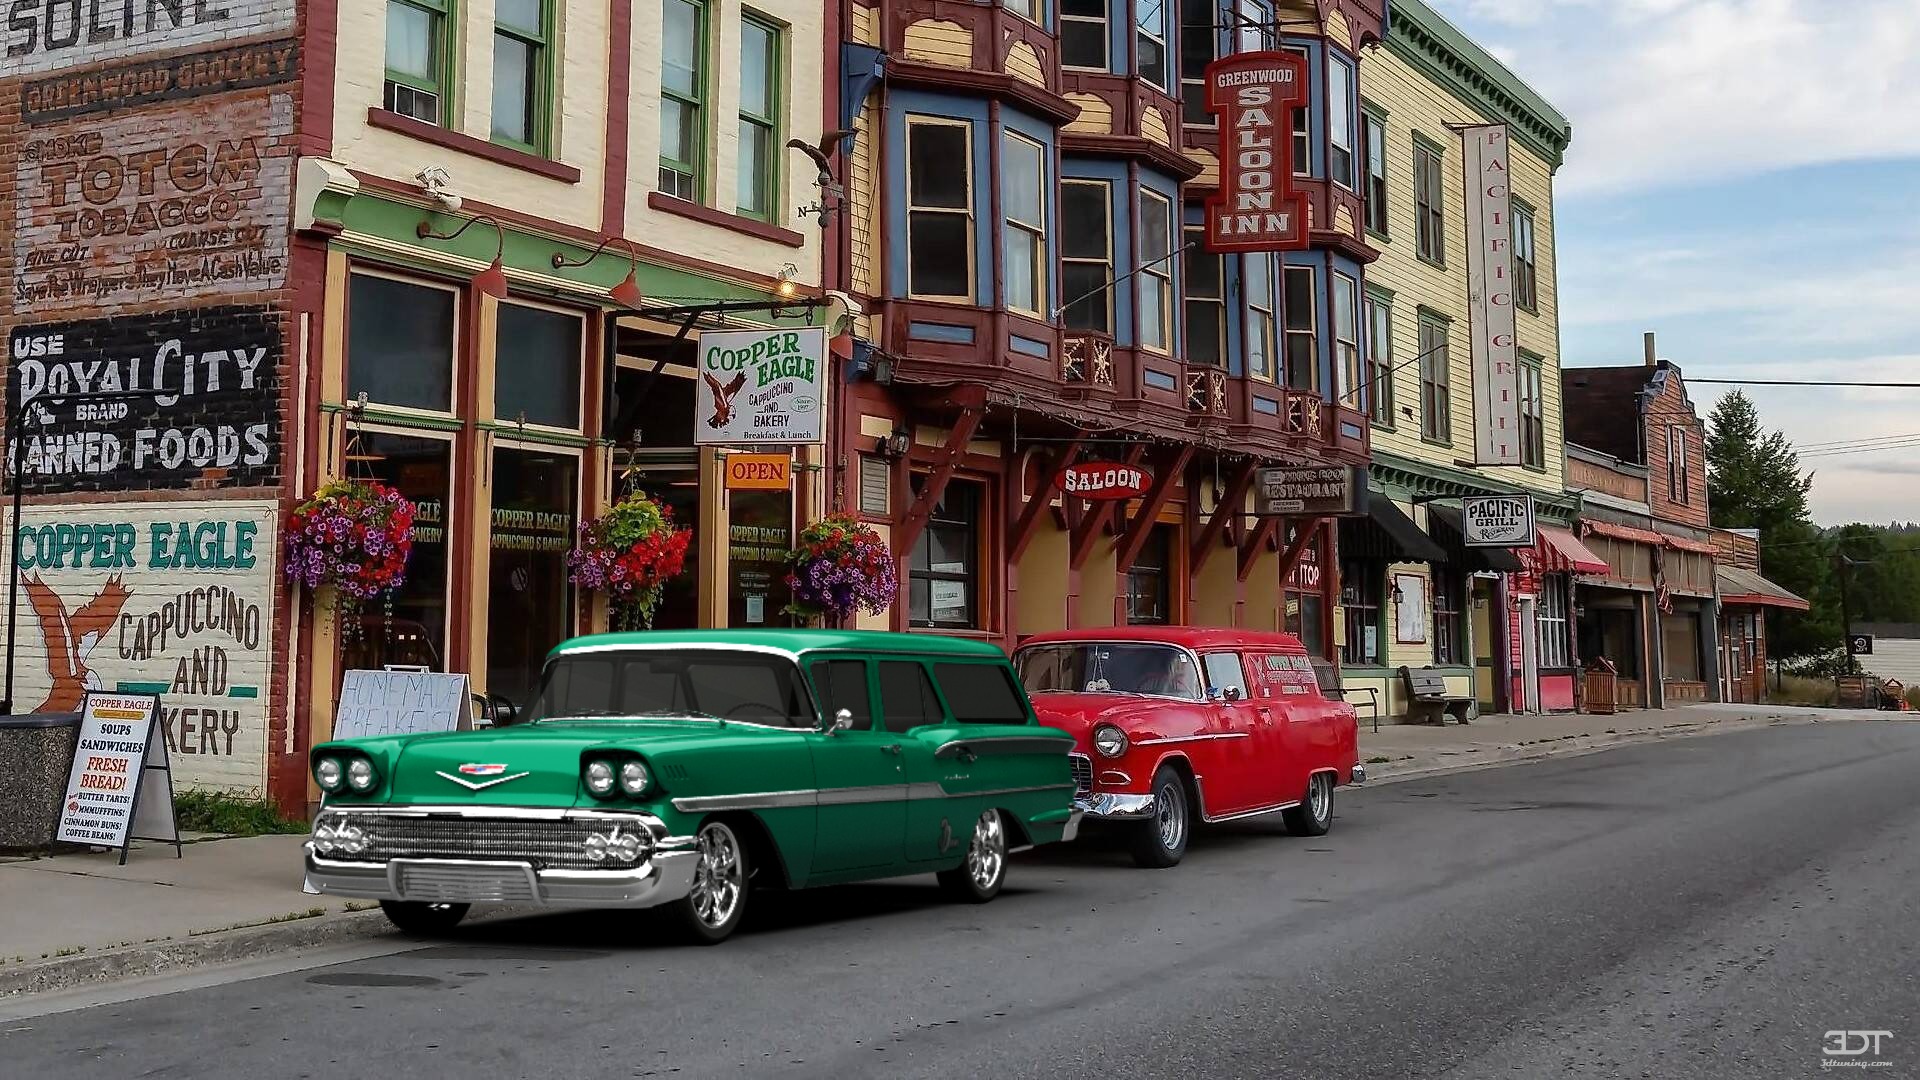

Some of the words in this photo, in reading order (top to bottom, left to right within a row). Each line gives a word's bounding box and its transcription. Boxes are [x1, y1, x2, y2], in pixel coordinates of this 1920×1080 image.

[1217, 69, 1293, 88] GREENWOOD
[25, 132, 103, 162] SMOKE
[1236, 86, 1273, 210] SALOON
[41, 139, 262, 206] TOTEM
[54, 191, 239, 242] TOBACCO
[1220, 213, 1289, 234] INN
[1486, 132, 1511, 306] PACIFIC
[25, 249, 54, 267] FINE
[59, 246, 89, 263] CUT
[211, 254, 242, 280] Cash
[242, 251, 281, 280] Value
[14, 335, 64, 358] USE
[706, 333, 800, 371] COPPER
[153, 338, 267, 407] CITY
[757, 356, 815, 388] EAGLE
[749, 382, 794, 407] CAPPUCCINO
[1492, 334, 1517, 458] GRILL
[76, 402, 129, 421] BRAND
[763, 402, 779, 414] AND
[753, 415, 790, 427] BAKERY
[743, 431, 779, 439] Breakfast
[788, 430, 812, 439] Lunch
[134, 424, 269, 470] FOODS
[732, 462, 784, 480] OPEN
[1065, 469, 1142, 492] SALOON
[413, 501, 440, 522] GLE
[1469, 499, 1524, 518] PACIFIC
[491, 508, 534, 529] COPPER
[536, 511, 571, 531] EAGLE
[1475, 517, 1519, 526] GRILL
[491, 533, 535, 551] APPUCCINO
[730, 525, 759, 543] OPPER
[17, 522, 137, 570] COPPER
[149, 520, 258, 570] EAGLE
[118, 584, 260, 661] CAPPUCCINO
[172, 644, 228, 697] AND
[89, 698, 122, 708] COPPER
[123, 699, 153, 710] EAGLE
[100, 723, 132, 736] SOUPS
[162, 708, 239, 756] KERY
[80, 738, 144, 754] SANDWICHES
[86, 756, 129, 774] FRESH
[79, 774, 127, 791] BREAD!
[77, 792, 105, 802] BUTTER
[105, 794, 130, 804] TARTS!
[64, 817, 101, 828] CINNAMON
[100, 820, 123, 831] BUNS!
[65, 828, 91, 838] COFFEE
[90, 830, 116, 841] BEANS!
